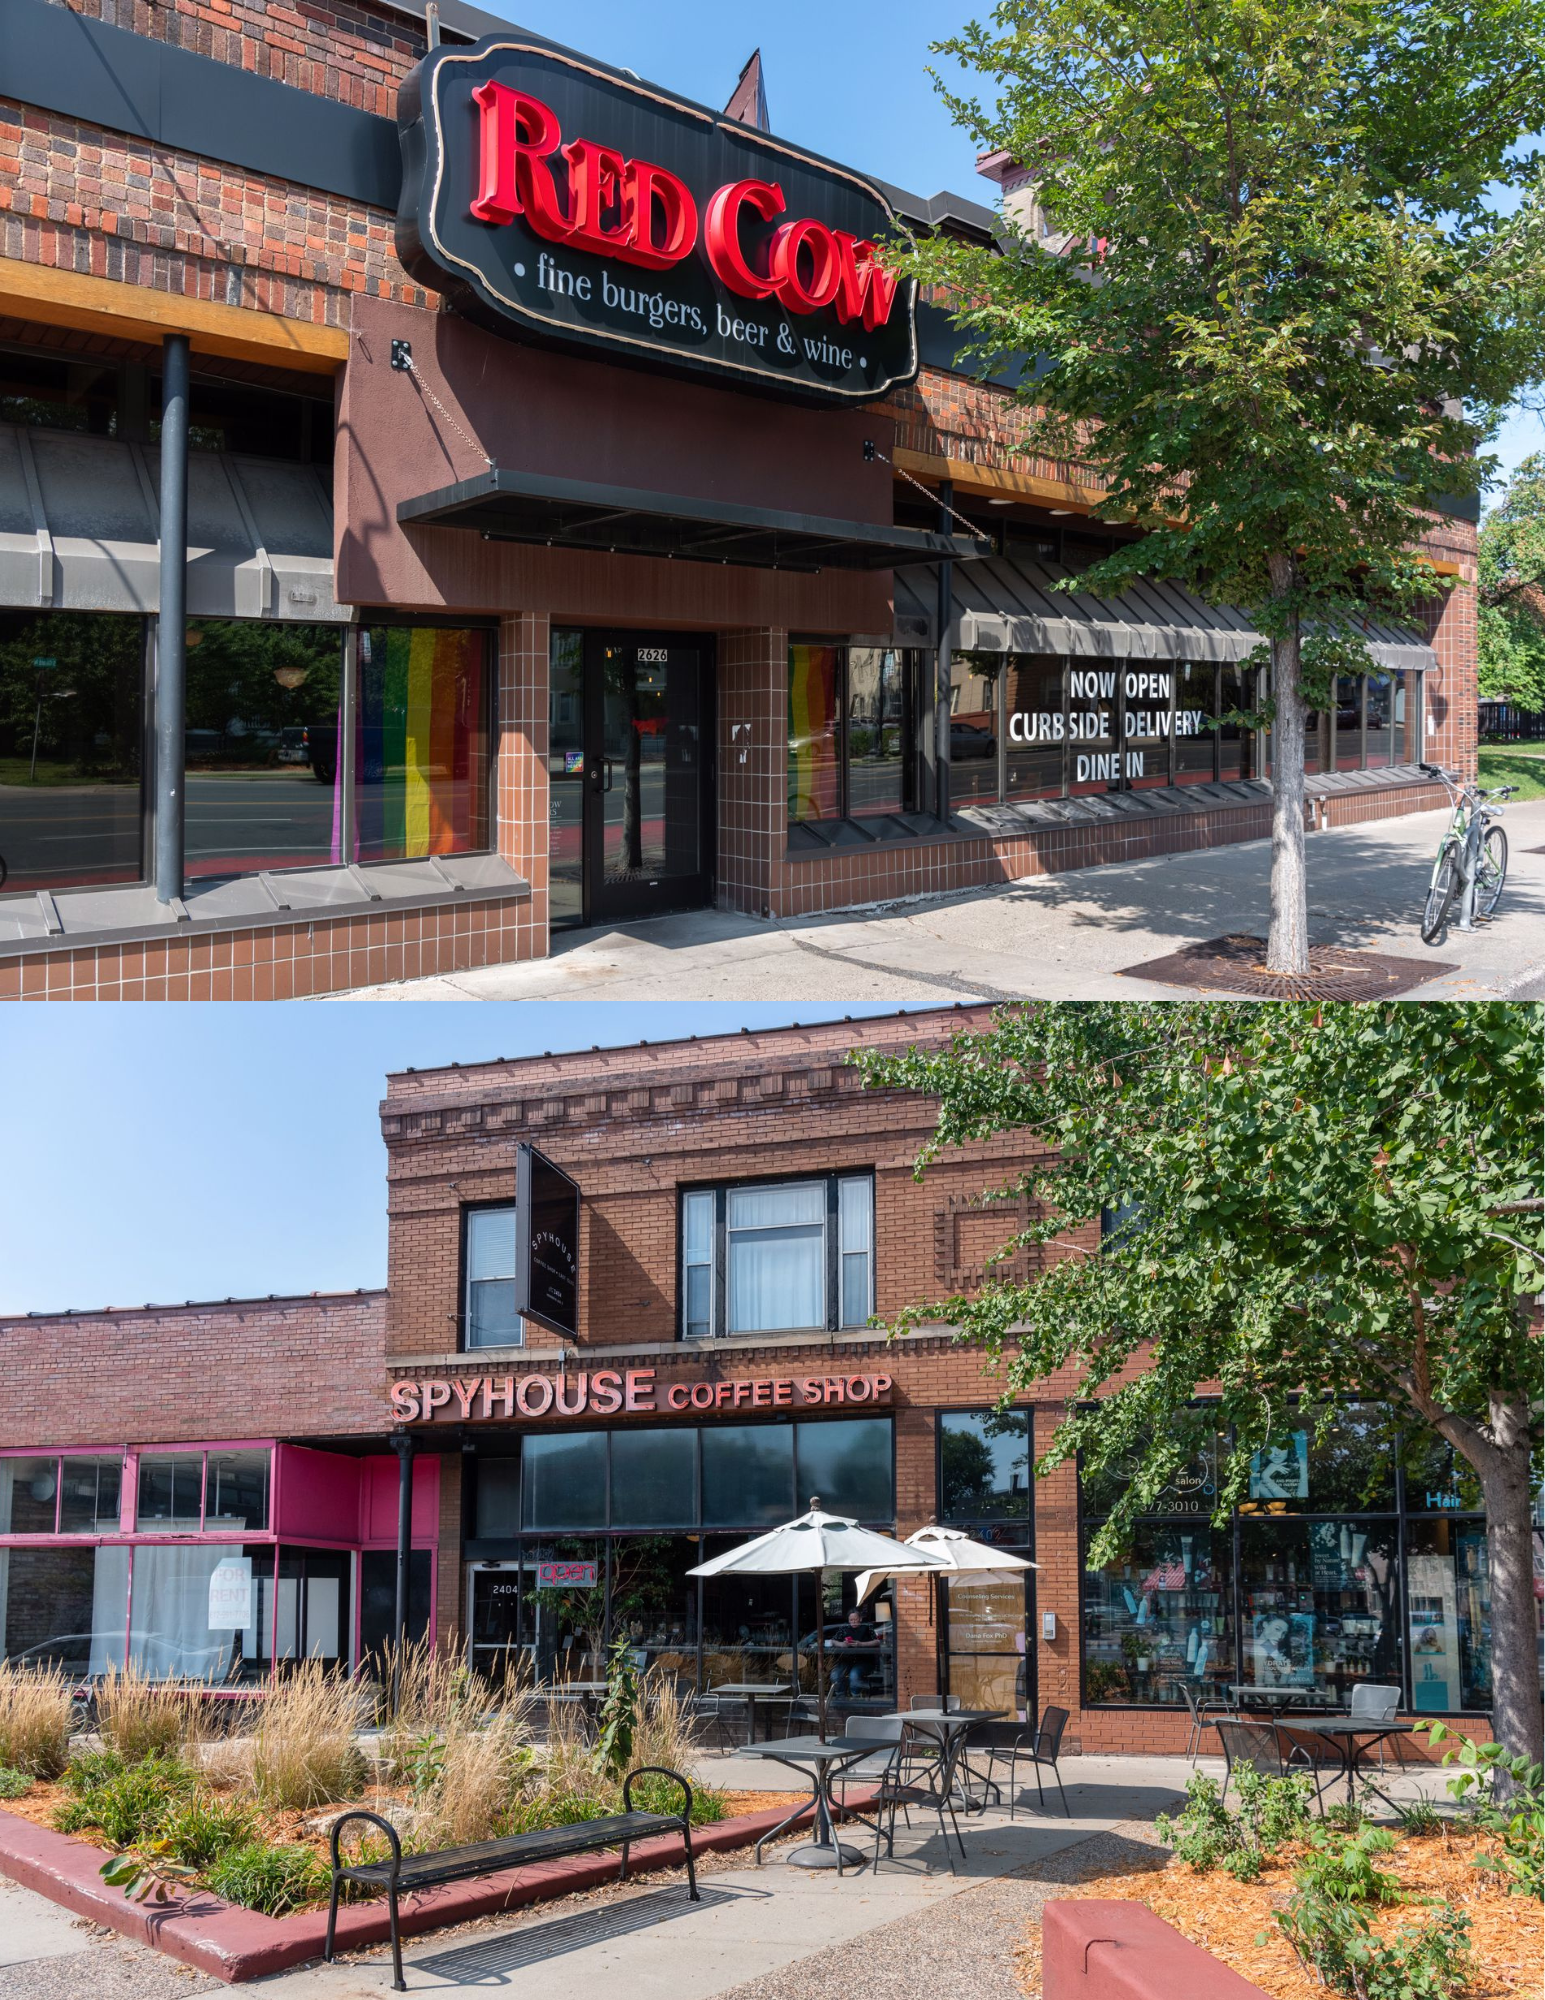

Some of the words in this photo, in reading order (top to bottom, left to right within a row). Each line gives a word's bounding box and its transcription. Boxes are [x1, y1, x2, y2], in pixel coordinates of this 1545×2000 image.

[470, 80, 699, 270] RED
[704, 178, 902, 332] COW
[537, 252, 592, 301] fine
[602, 270, 708, 336] burgers,
[716, 303, 769, 347] beer
[776, 322, 796, 355] &
[803, 335, 853, 370] wine
[638, 649, 667, 661] 2626
[1070, 671, 1115, 698] NOW
[1125, 672, 1170, 699] OPEN
[1125, 710, 1202, 738] DELIVERY
[1077, 753, 1120, 782] DINE
[1126, 751, 1144, 777] IN
[390, 1369, 658, 1422] SPYHOUSE
[668, 1379, 793, 1410] COFFEE
[803, 1374, 893, 1405] SHOP
[1175, 1475, 1201, 1485] salon
[1426, 1491, 1461, 1508] Hair
[215, 1568, 246, 1582] FOR
[539, 1563, 596, 1585] open
[210, 1588, 250, 1602] RENT
[493, 1585, 518, 1594] 2404
[957, 1593, 990, 1601] Counseling
